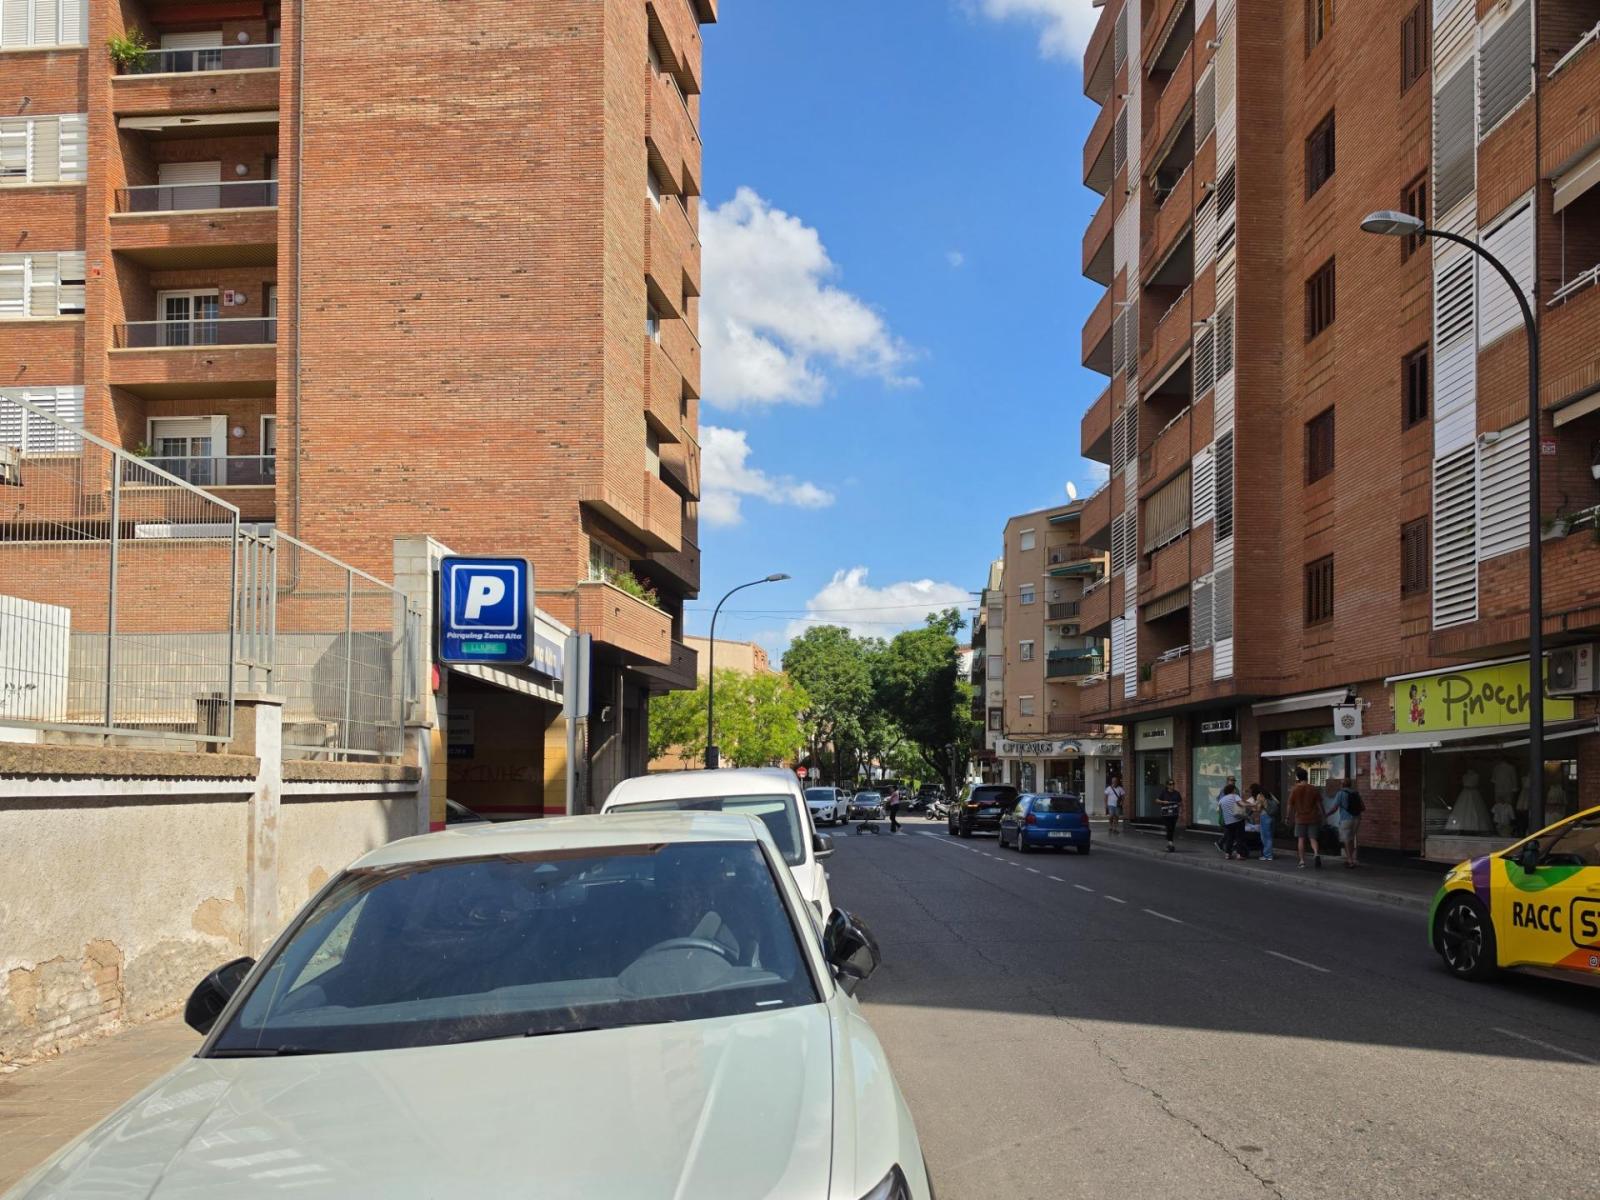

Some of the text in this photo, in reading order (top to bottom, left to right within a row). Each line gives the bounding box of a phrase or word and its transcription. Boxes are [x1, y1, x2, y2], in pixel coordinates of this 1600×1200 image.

[464, 575, 506, 619] P
[484, 632, 504, 640] Zona
[505, 632, 522, 640] Alta
[1513, 901, 1600, 938] RACC S
